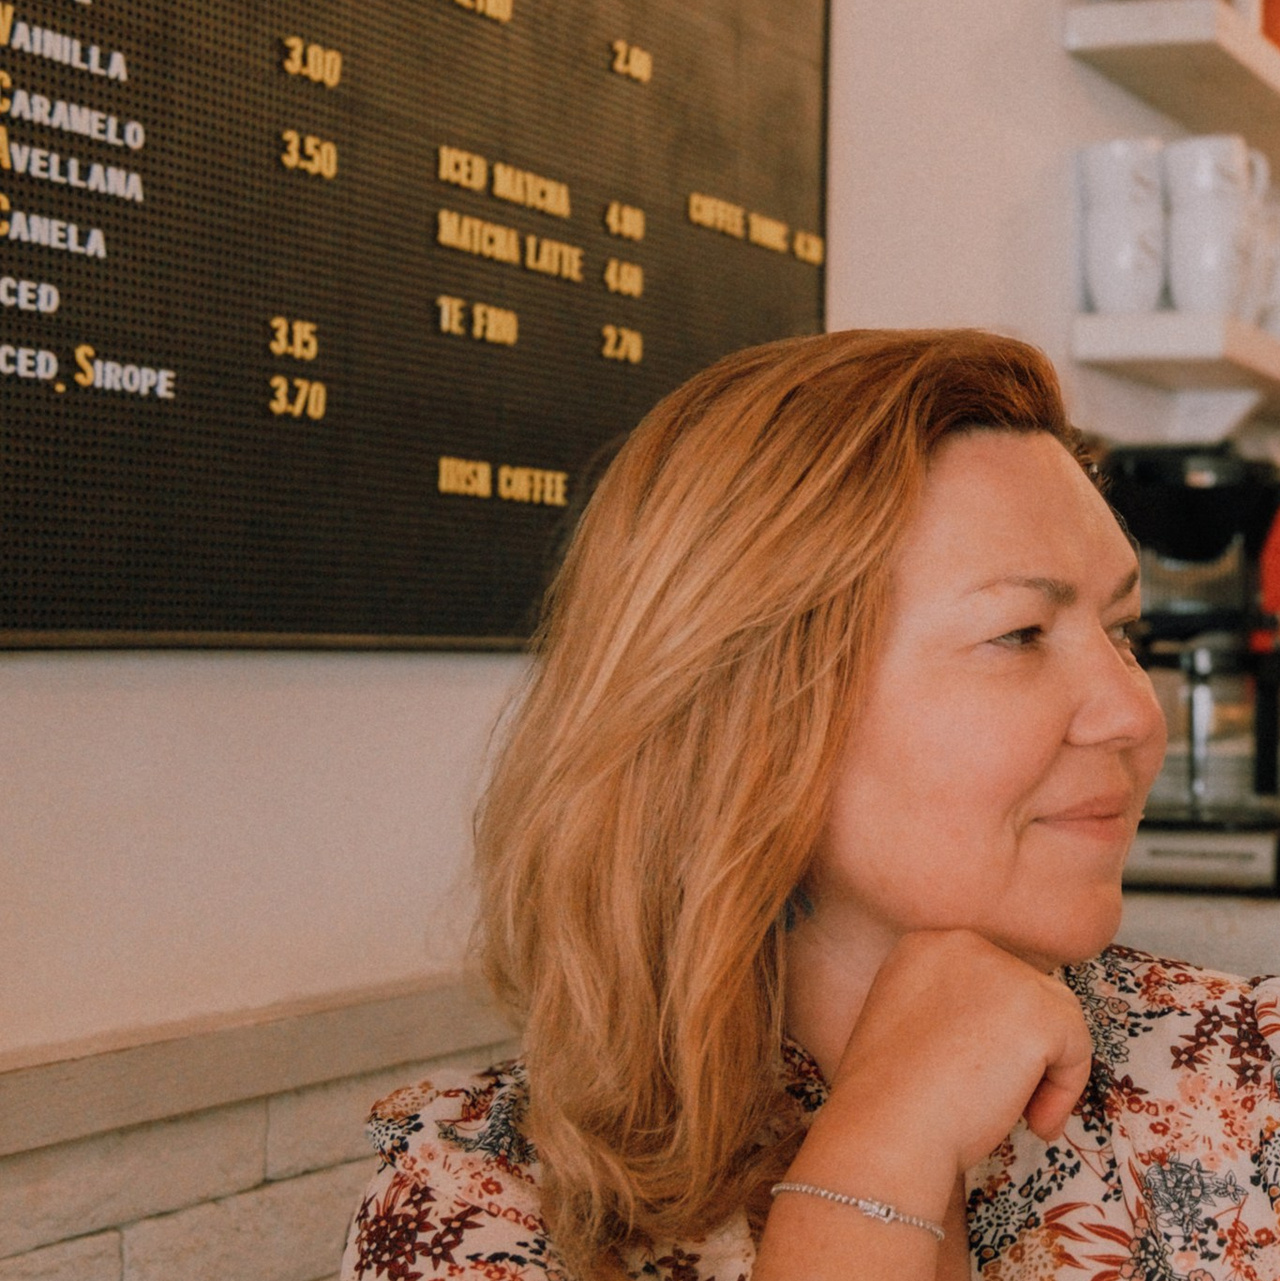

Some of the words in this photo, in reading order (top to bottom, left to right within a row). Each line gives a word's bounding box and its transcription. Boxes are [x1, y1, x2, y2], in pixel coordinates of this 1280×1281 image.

[0, 2, 129, 83] VAINILLA
[281, 129, 338, 180] 3.50
[438, 144, 489, 192] ICED
[493, 161, 572, 219] MATCHA
[438, 208, 521, 265] MATCHA
[525, 233, 585, 283] LATTE
[0, 276, 61, 314] CED
[74, 344, 176, 400] SIROPE
[269, 375, 327, 420] 3.70
[497, 465, 569, 507] COFFEE
